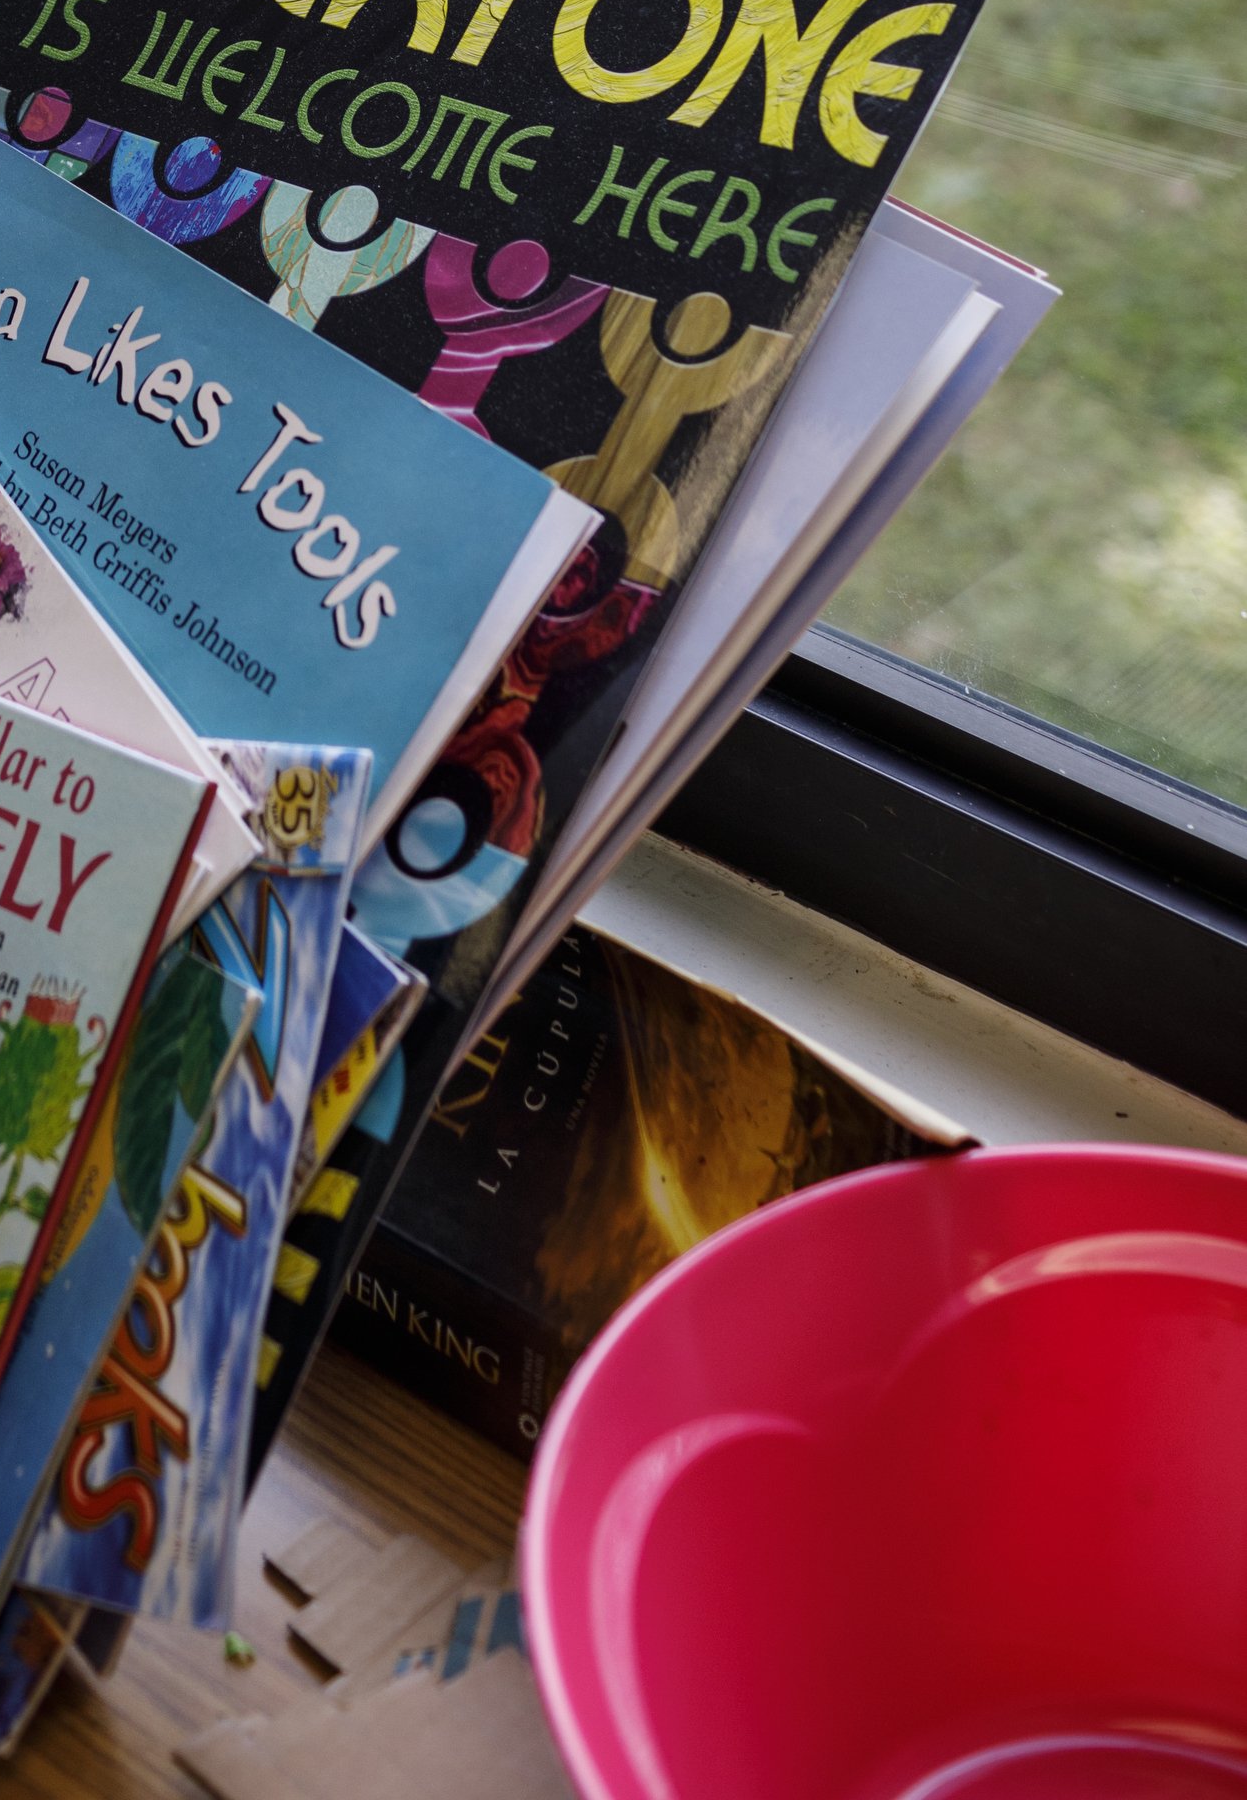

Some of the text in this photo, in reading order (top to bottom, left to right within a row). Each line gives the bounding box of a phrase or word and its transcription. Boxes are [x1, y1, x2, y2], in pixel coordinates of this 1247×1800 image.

[122, 9, 553, 204] WELCOME
[574, 145, 836, 283] HERE
[13, 431, 86, 500] Susan
[90, 482, 178, 564] Meyers
[41, 277, 233, 448] Likes
[236, 403, 400, 650] Tools
[30, 493, 87, 555] Beth
[93, 542, 172, 616] Griffis
[173, 602, 278, 697] Johnson
[53, 759, 96, 814] to
[275, 767, 317, 835] 35
[477, 1147, 520, 1194] LA
[407, 1302, 501, 1386] KING
